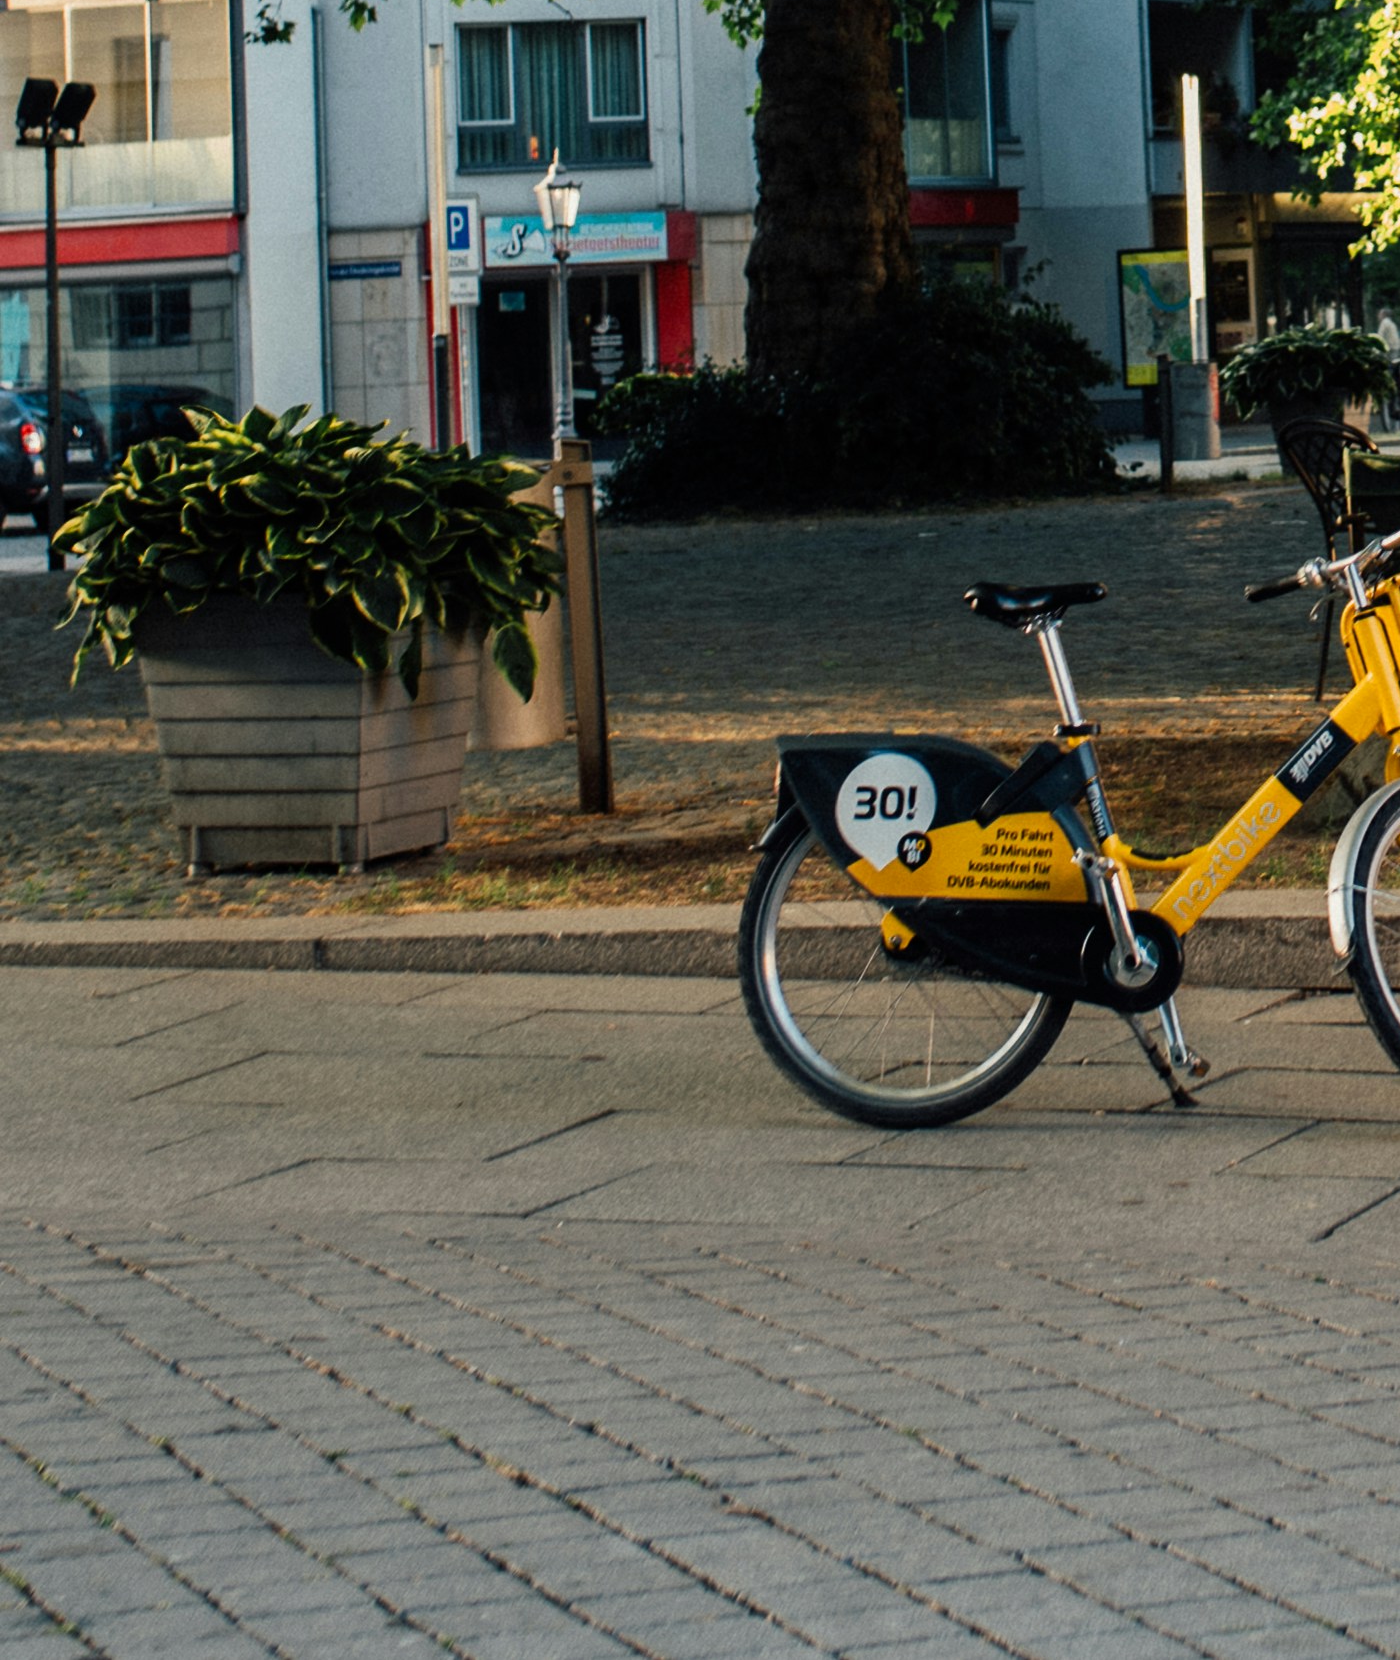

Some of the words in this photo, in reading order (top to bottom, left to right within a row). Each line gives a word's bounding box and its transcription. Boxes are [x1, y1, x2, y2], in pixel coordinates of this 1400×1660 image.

[449, 211, 464, 245] P
[1303, 730, 1334, 767] DVB
[853, 785, 918, 820] 30!
[996, 828, 1017, 841] Pro
[1021, 829, 1054, 842] Fahrt
[981, 844, 998, 856] 30
[1000, 844, 1053, 858] Minuten
[1172, 802, 1281, 920] nextbike
[968, 860, 1031, 873] kostenfrei
[1033, 861, 1052, 874] für
[947, 875, 1051, 891] DVB-Abokunden
